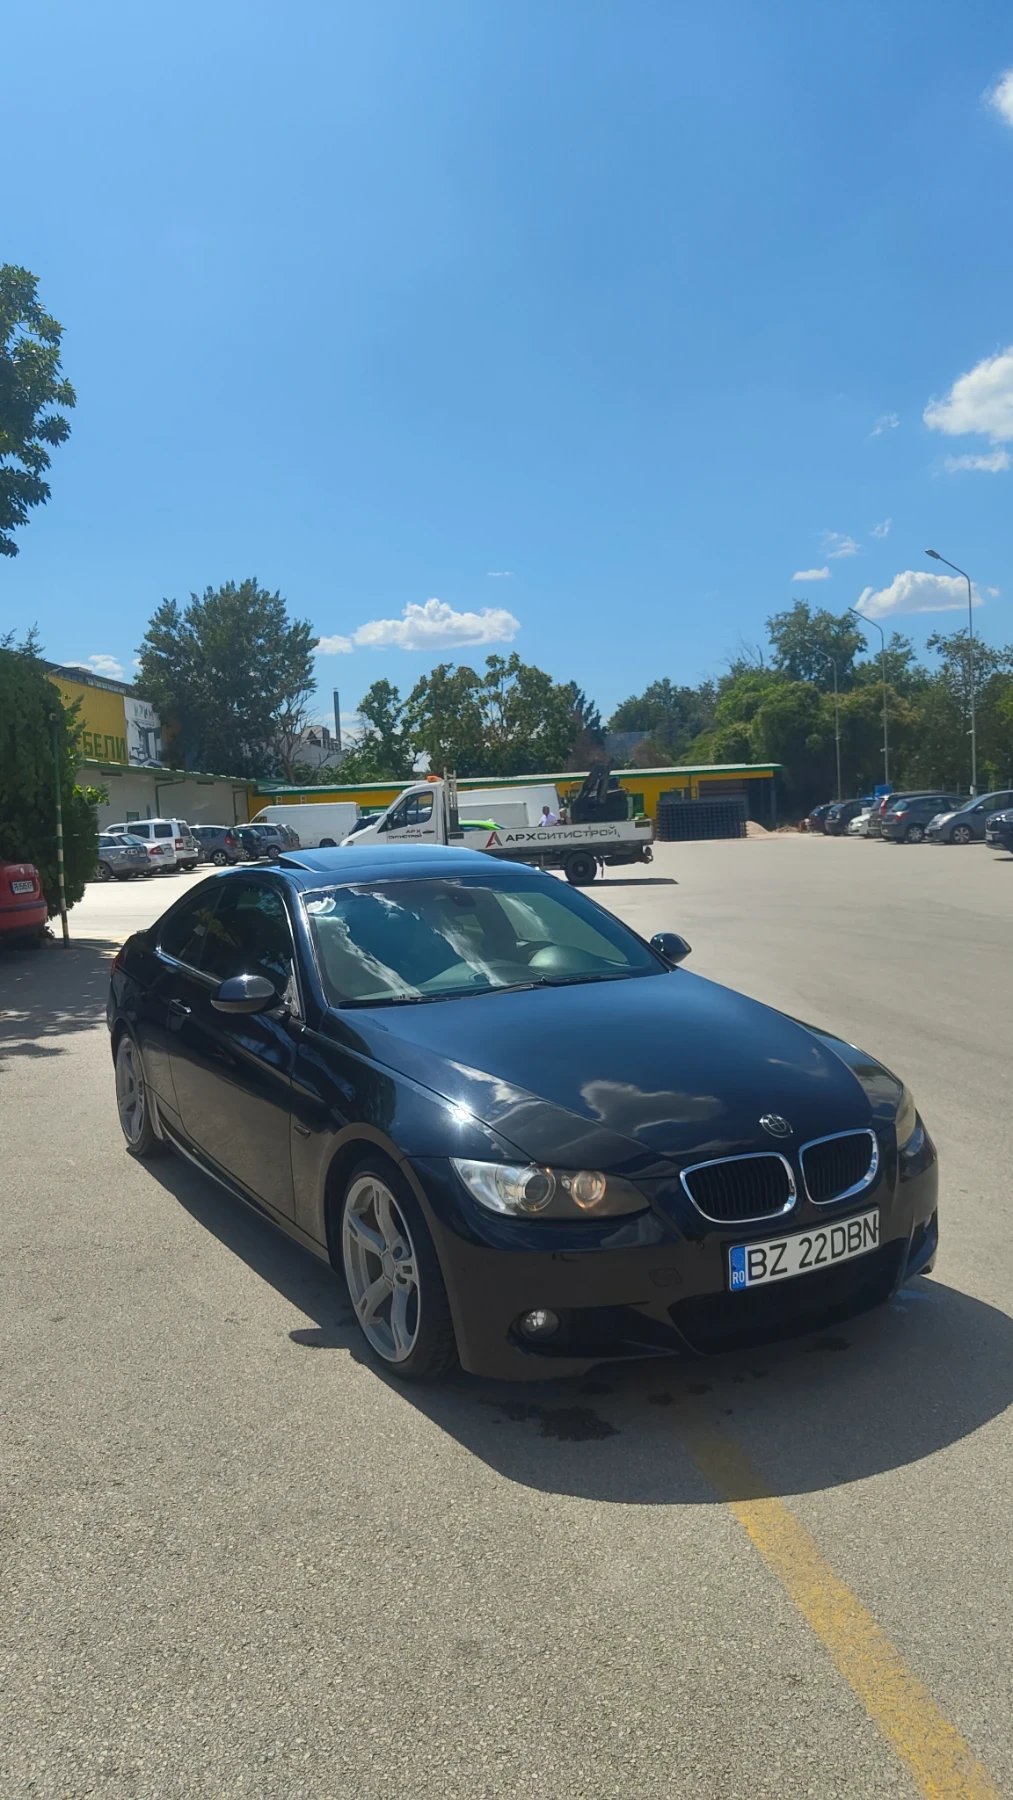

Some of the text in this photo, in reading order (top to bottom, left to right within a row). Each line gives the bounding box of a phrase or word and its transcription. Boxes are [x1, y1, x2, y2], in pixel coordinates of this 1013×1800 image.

[748, 1214, 877, 1281] BZ 22DBN
[733, 1270, 745, 1284] RO
